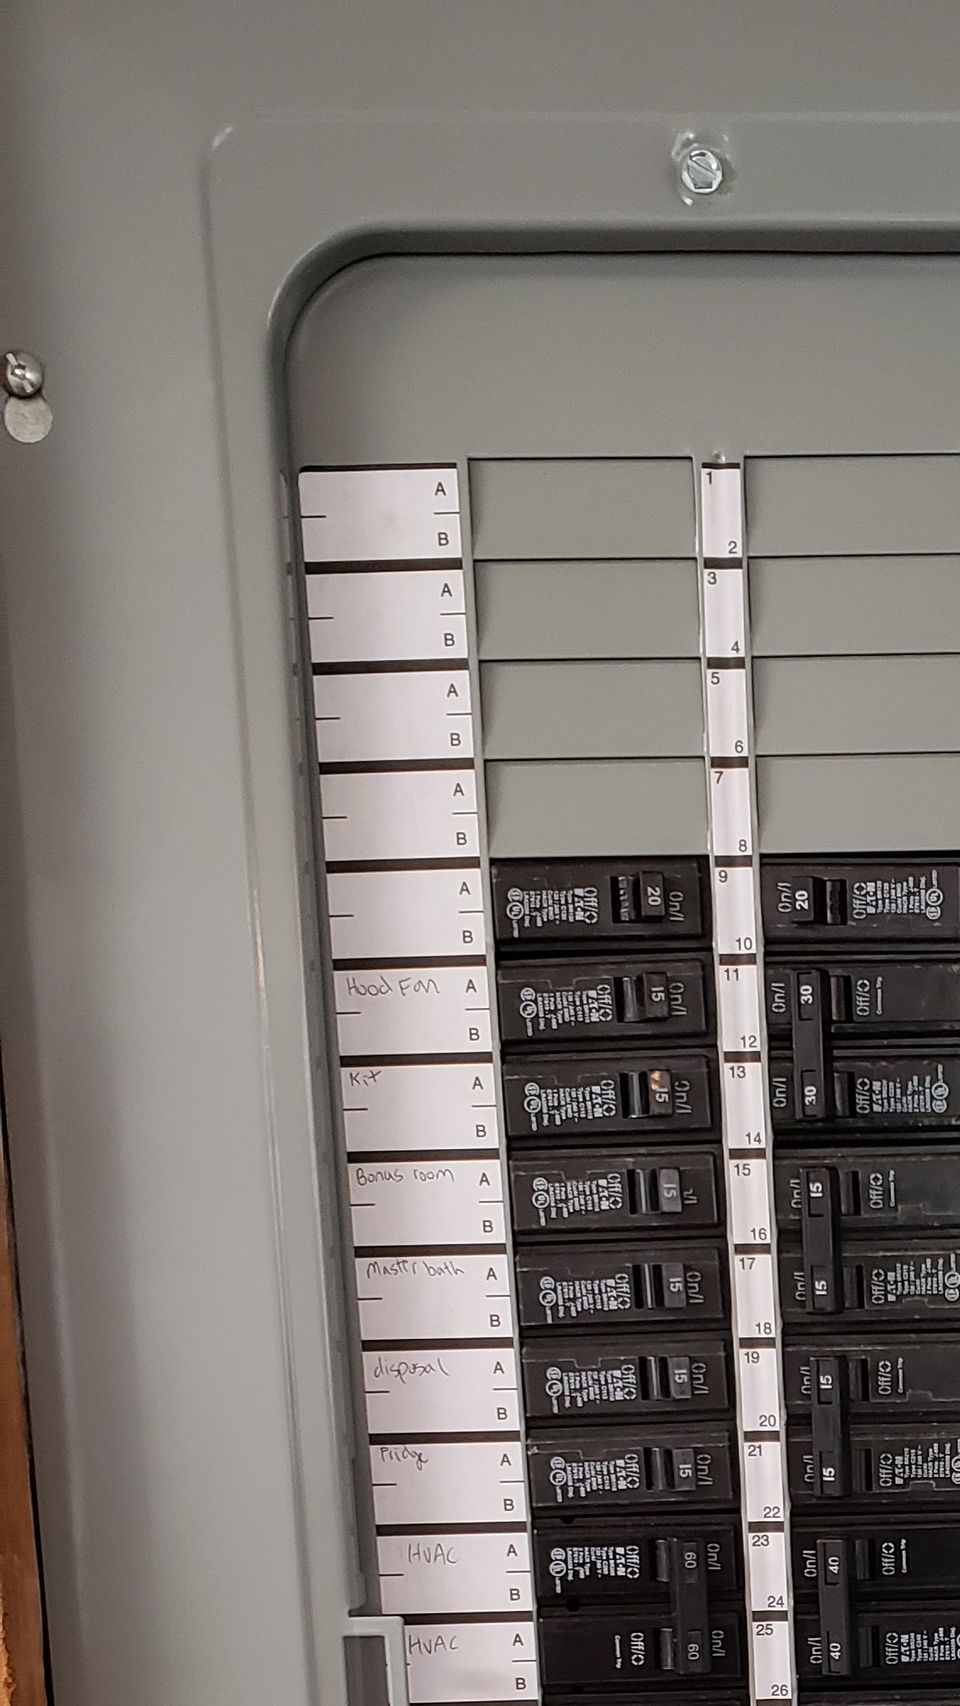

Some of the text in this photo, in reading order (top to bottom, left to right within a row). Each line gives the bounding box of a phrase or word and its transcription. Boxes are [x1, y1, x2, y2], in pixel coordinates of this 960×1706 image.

[706, 471, 713, 485] 1
[728, 540, 738, 555] 2
[707, 571, 717, 586] 3
[710, 671, 721, 686] 5
[714, 770, 724, 785] 7
[738, 838, 748, 853] 8
[718, 869, 728, 884] 9
[459, 881, 471, 896] A
[647, 886, 662, 906] 20
[795, 890, 809, 910] 20
[462, 929, 474, 944] B
[735, 936, 753, 951] 10
[723, 967, 739, 982] 11
[651, 986, 665, 1002] 15
[799, 985, 813, 1005] 30
[728, 1065, 747, 1079] 13
[654, 1085, 669, 1104] 15
[804, 1085, 817, 1106] 30
[733, 1163, 751, 1177] 15
[662, 1183, 677, 1198] 15
[809, 1182, 823, 1197] 15
[738, 1257, 756, 1271] 17
[743, 1350, 760, 1364] 19
[674, 1369, 688, 1383] 15
[758, 1414, 777, 1428] 20
[747, 1444, 763, 1457] 21
[751, 1534, 770, 1547] 23
[684, 1551, 697, 1569] 60
[828, 1556, 839, 1574] 40
[755, 1623, 774, 1637] 25
[687, 1643, 700, 1660] 60
[829, 1642, 841, 1660] 40
